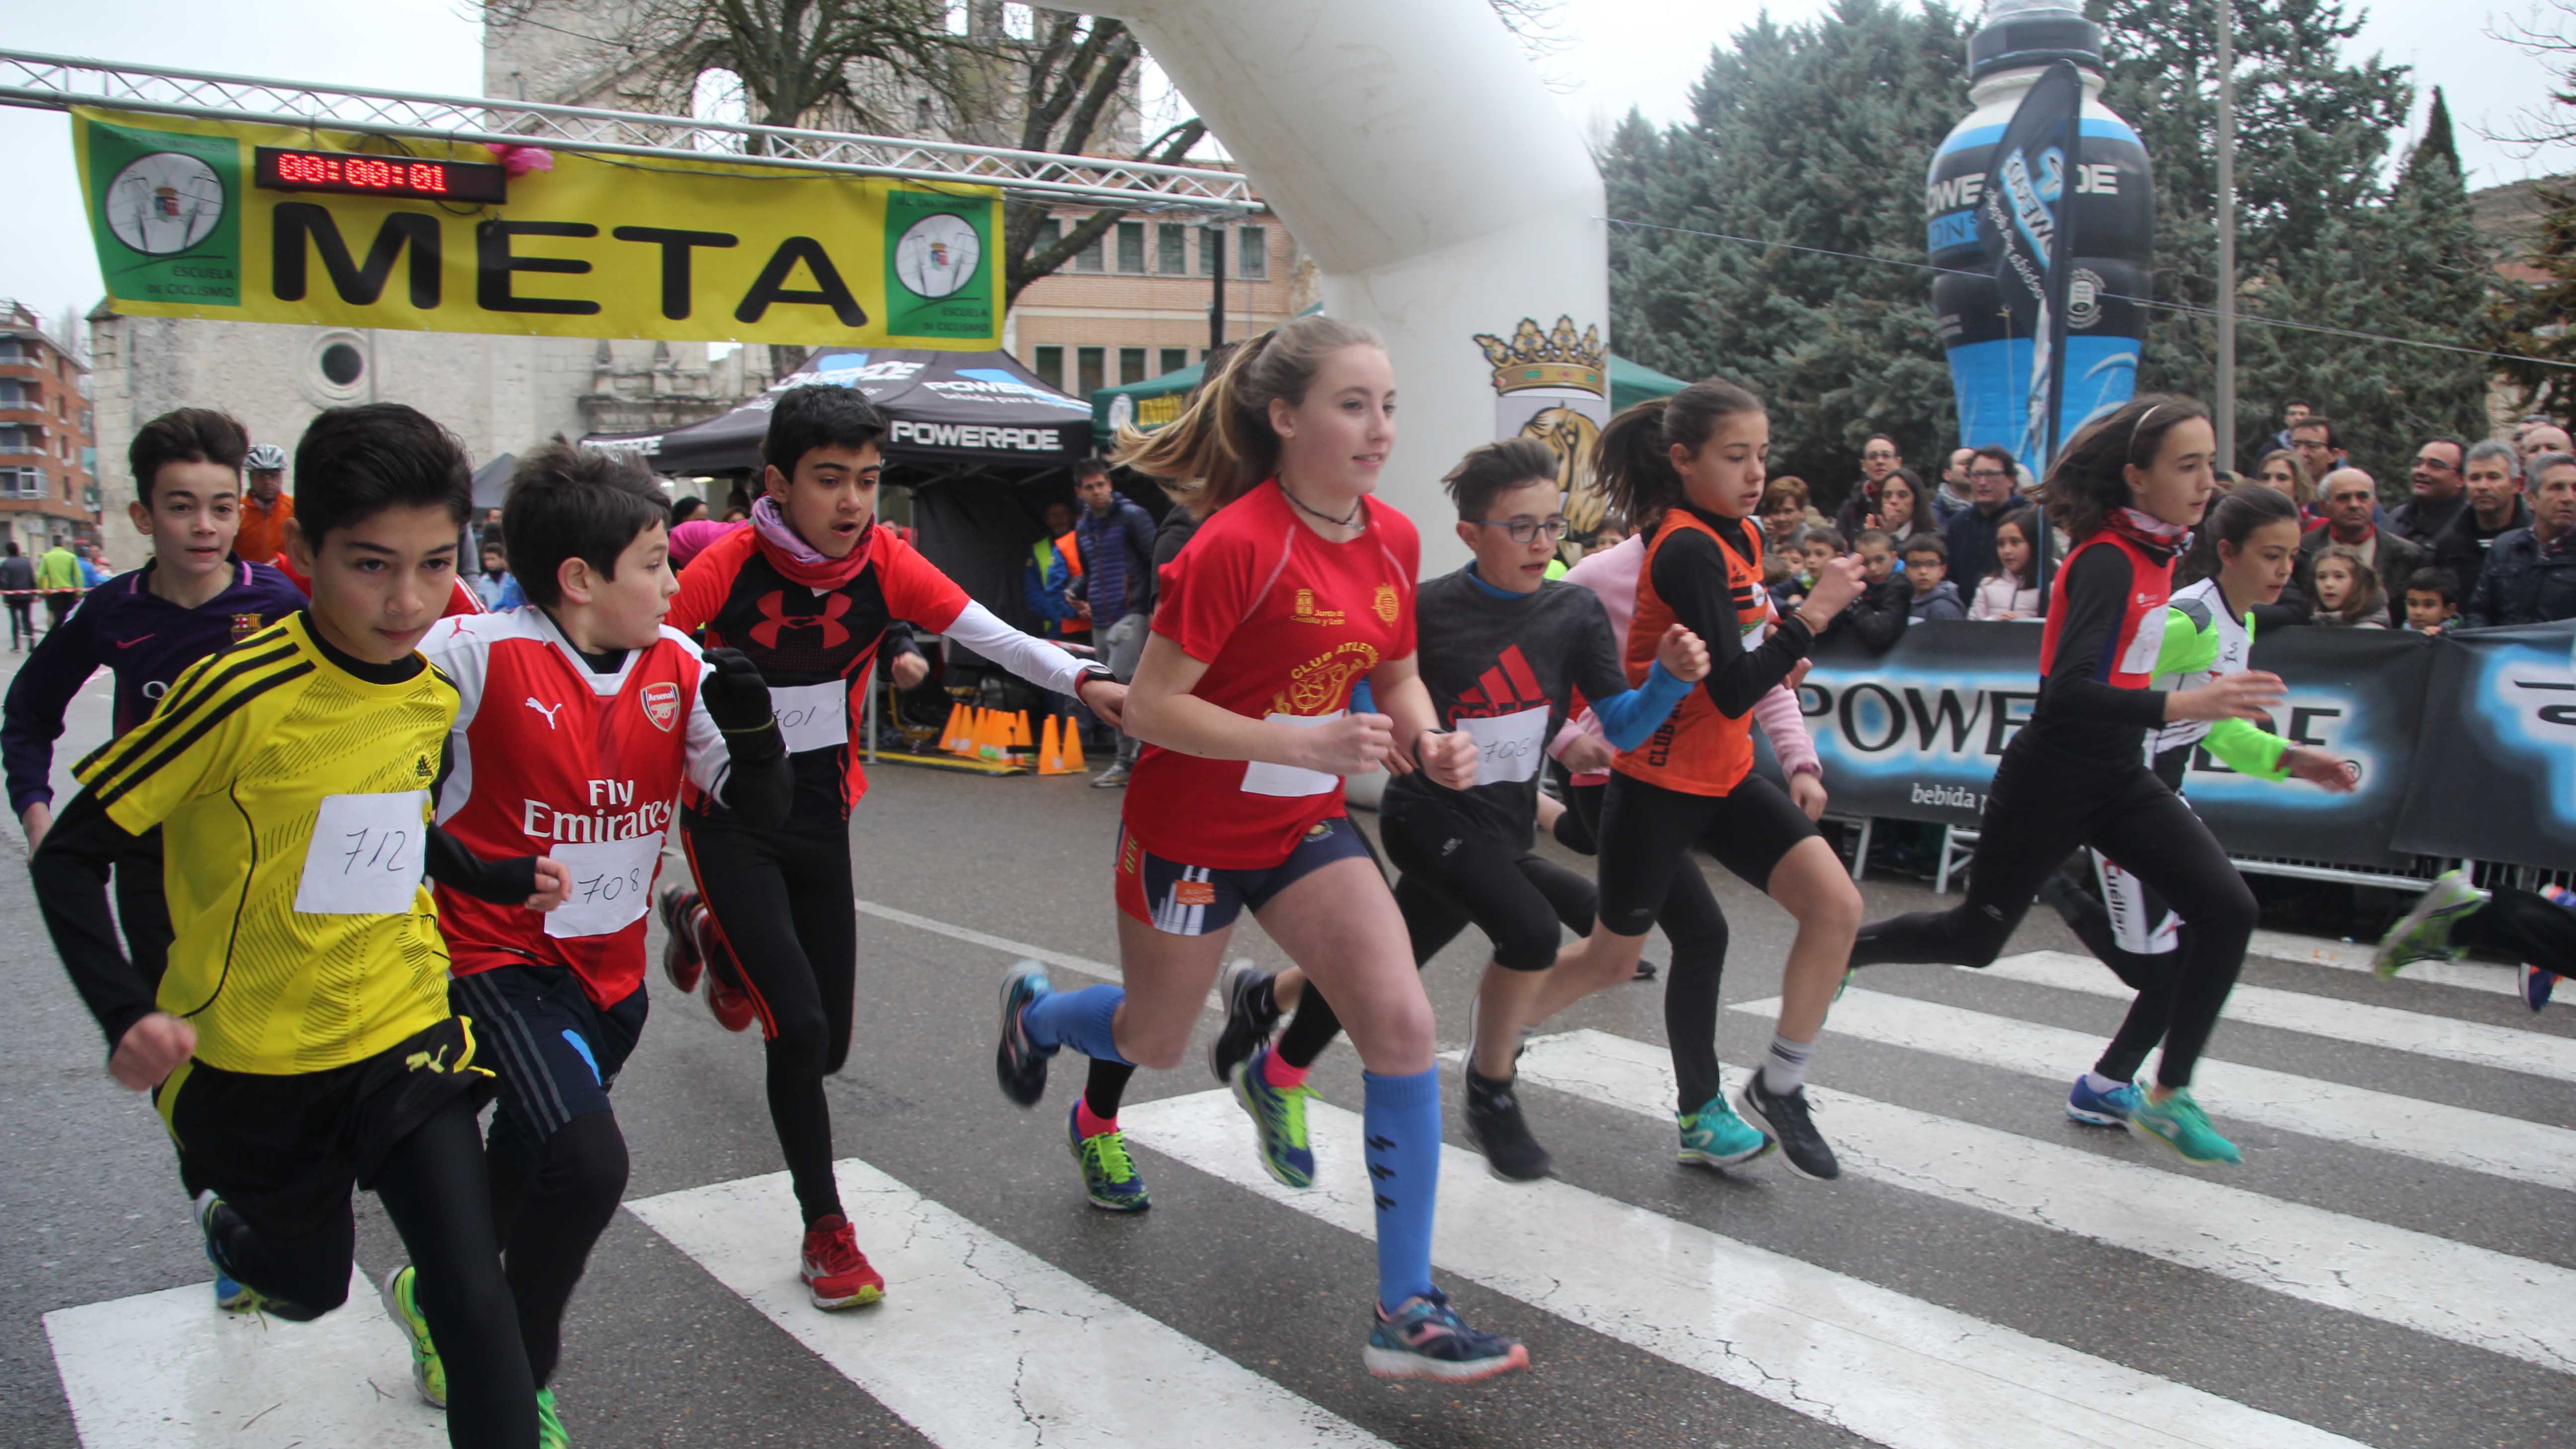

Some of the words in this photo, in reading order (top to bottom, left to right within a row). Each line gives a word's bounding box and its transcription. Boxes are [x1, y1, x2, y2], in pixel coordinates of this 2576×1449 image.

[278, 153, 446, 193] 00:00:01
[173, 266, 234, 279] ESCUELA
[272, 201, 869, 327] META
[167, 284, 234, 298] CICLISMO
[942, 307, 988, 318] ESCUELA
[891, 420, 1062, 451] POWERADE
[1290, 651, 1333, 680] CLUB
[648, 690, 674, 702] Arsenal
[1650, 723, 1674, 767] CLUB
[587, 779, 634, 807] Fly
[1911, 782, 1976, 809] bebida
[523, 799, 672, 843] Emirates
[344, 827, 406, 875] 712
[578, 867, 640, 904] 708
